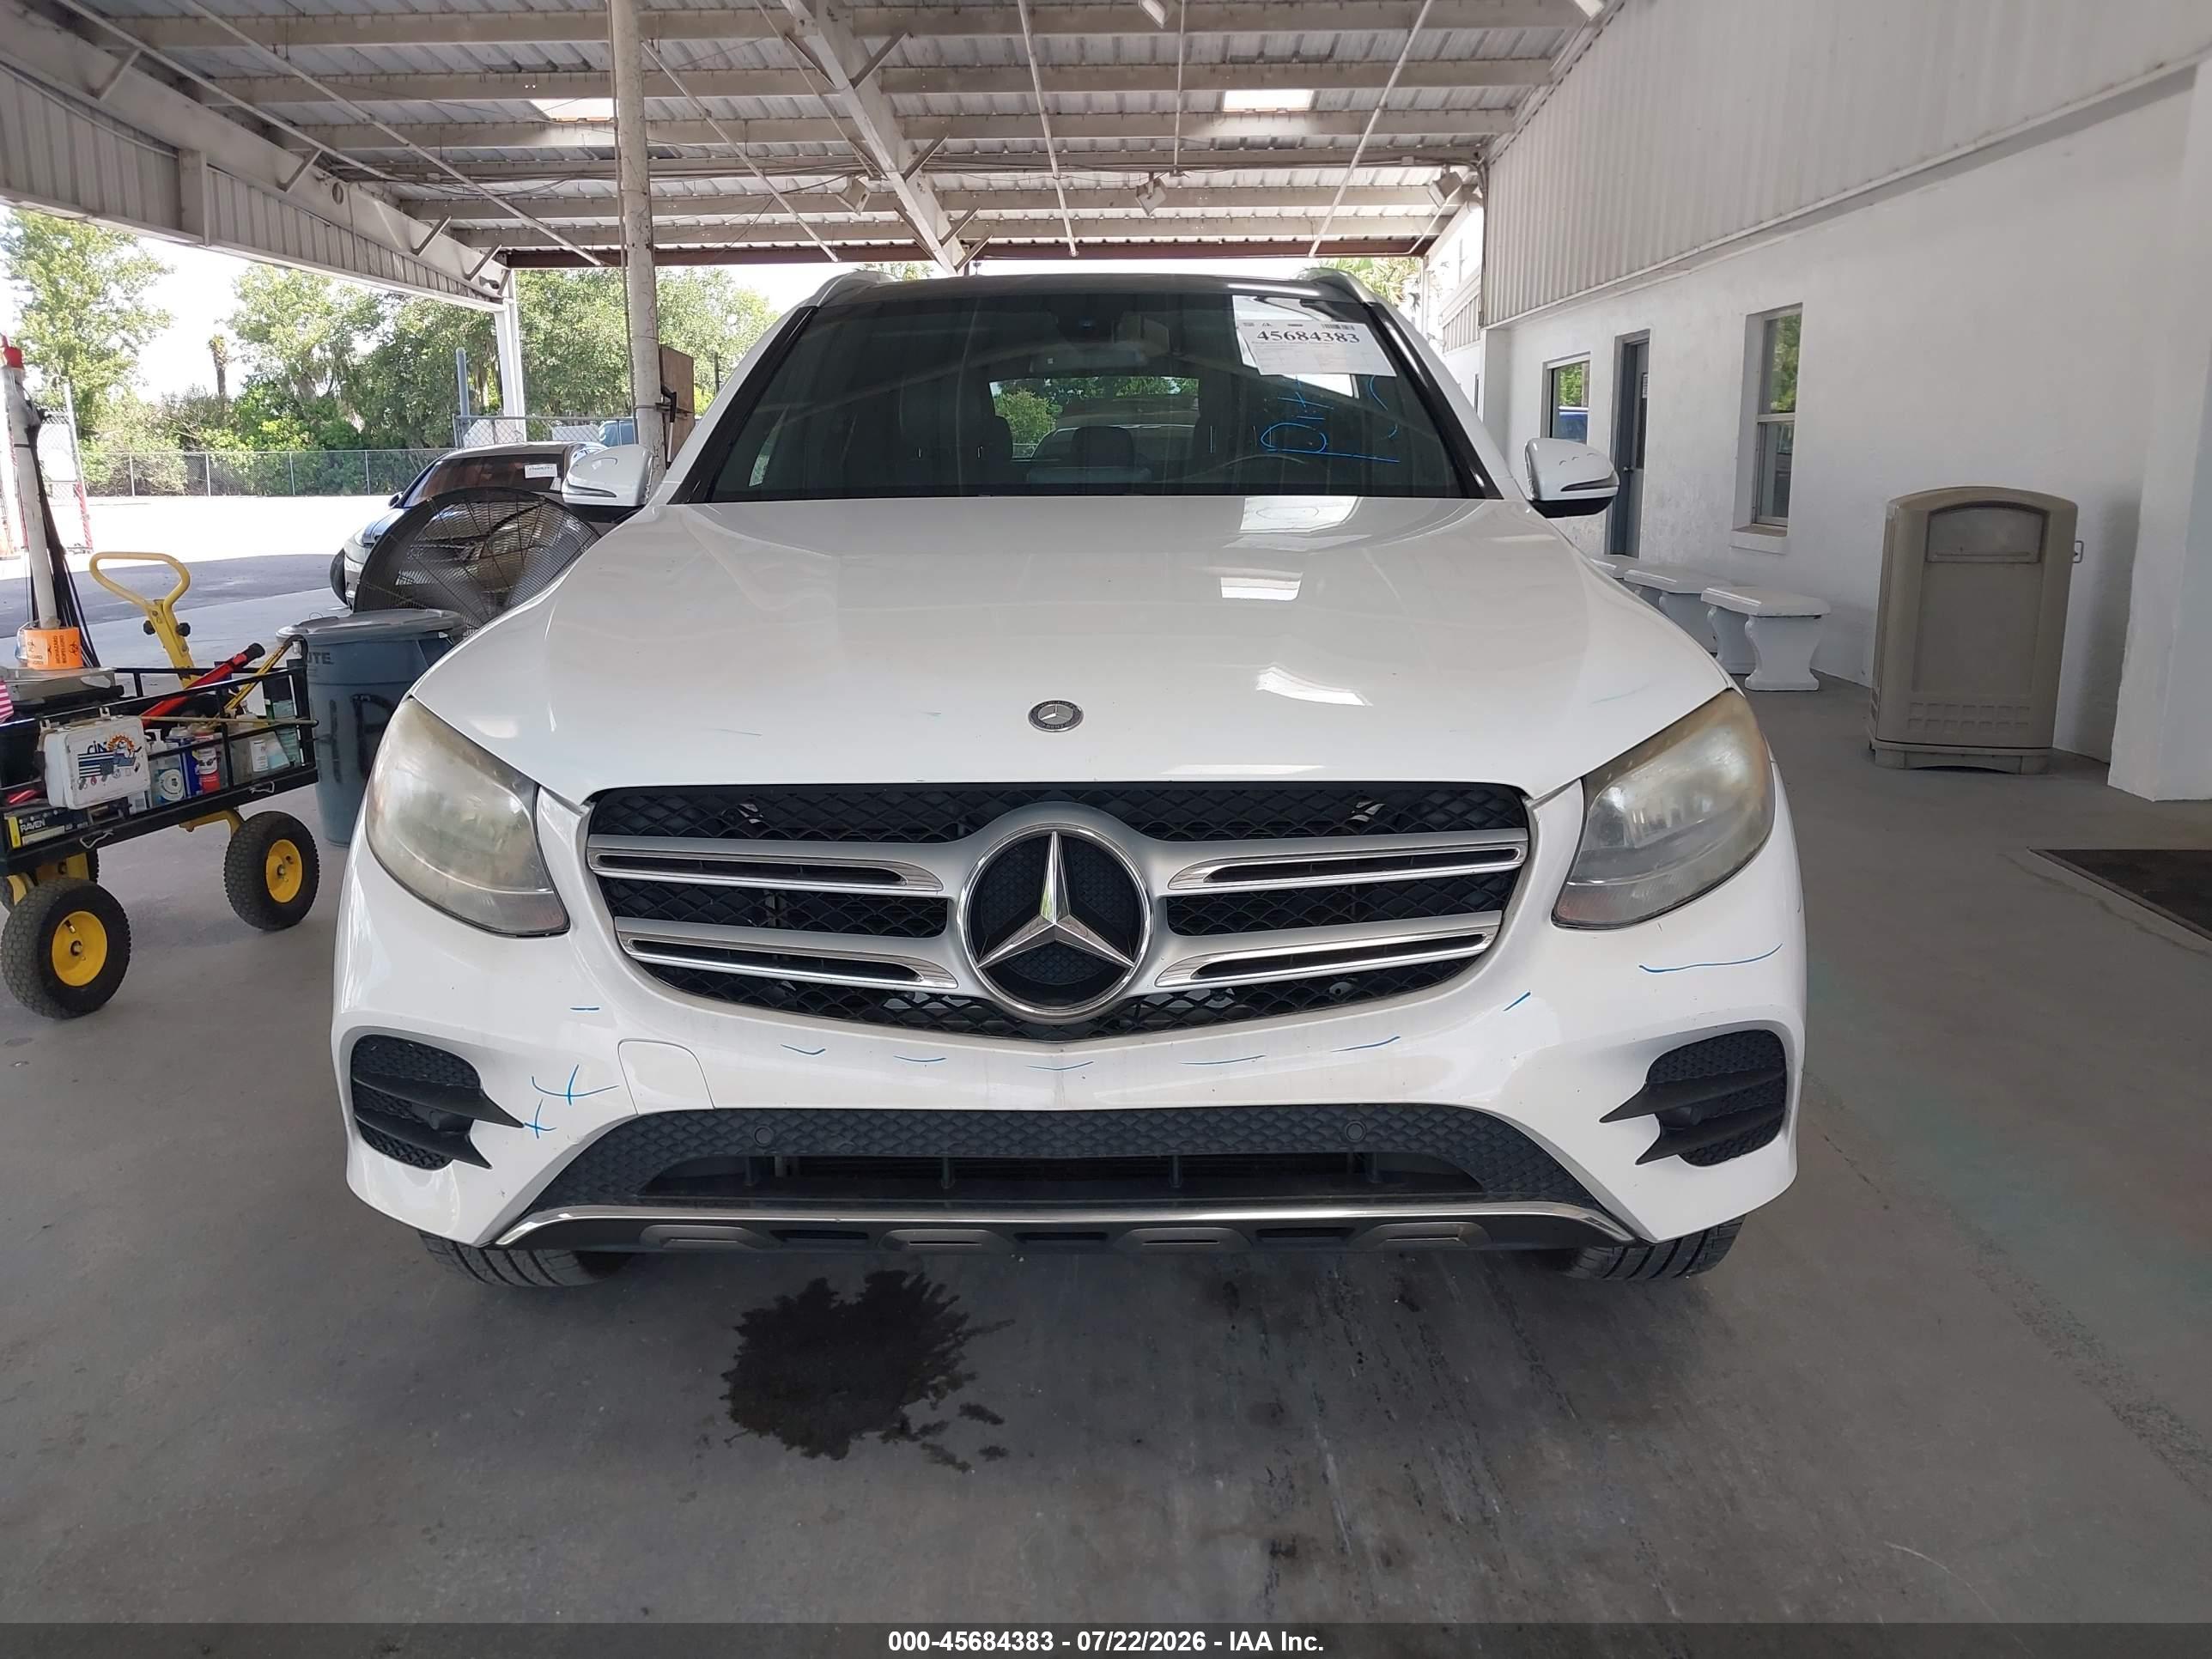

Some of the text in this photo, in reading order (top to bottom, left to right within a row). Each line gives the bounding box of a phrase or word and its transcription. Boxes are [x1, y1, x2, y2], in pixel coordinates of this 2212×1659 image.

[1257, 330, 1360, 344] 45684383
[307, 652, 332, 665] UTE
[20, 818, 46, 833] RAVEN
